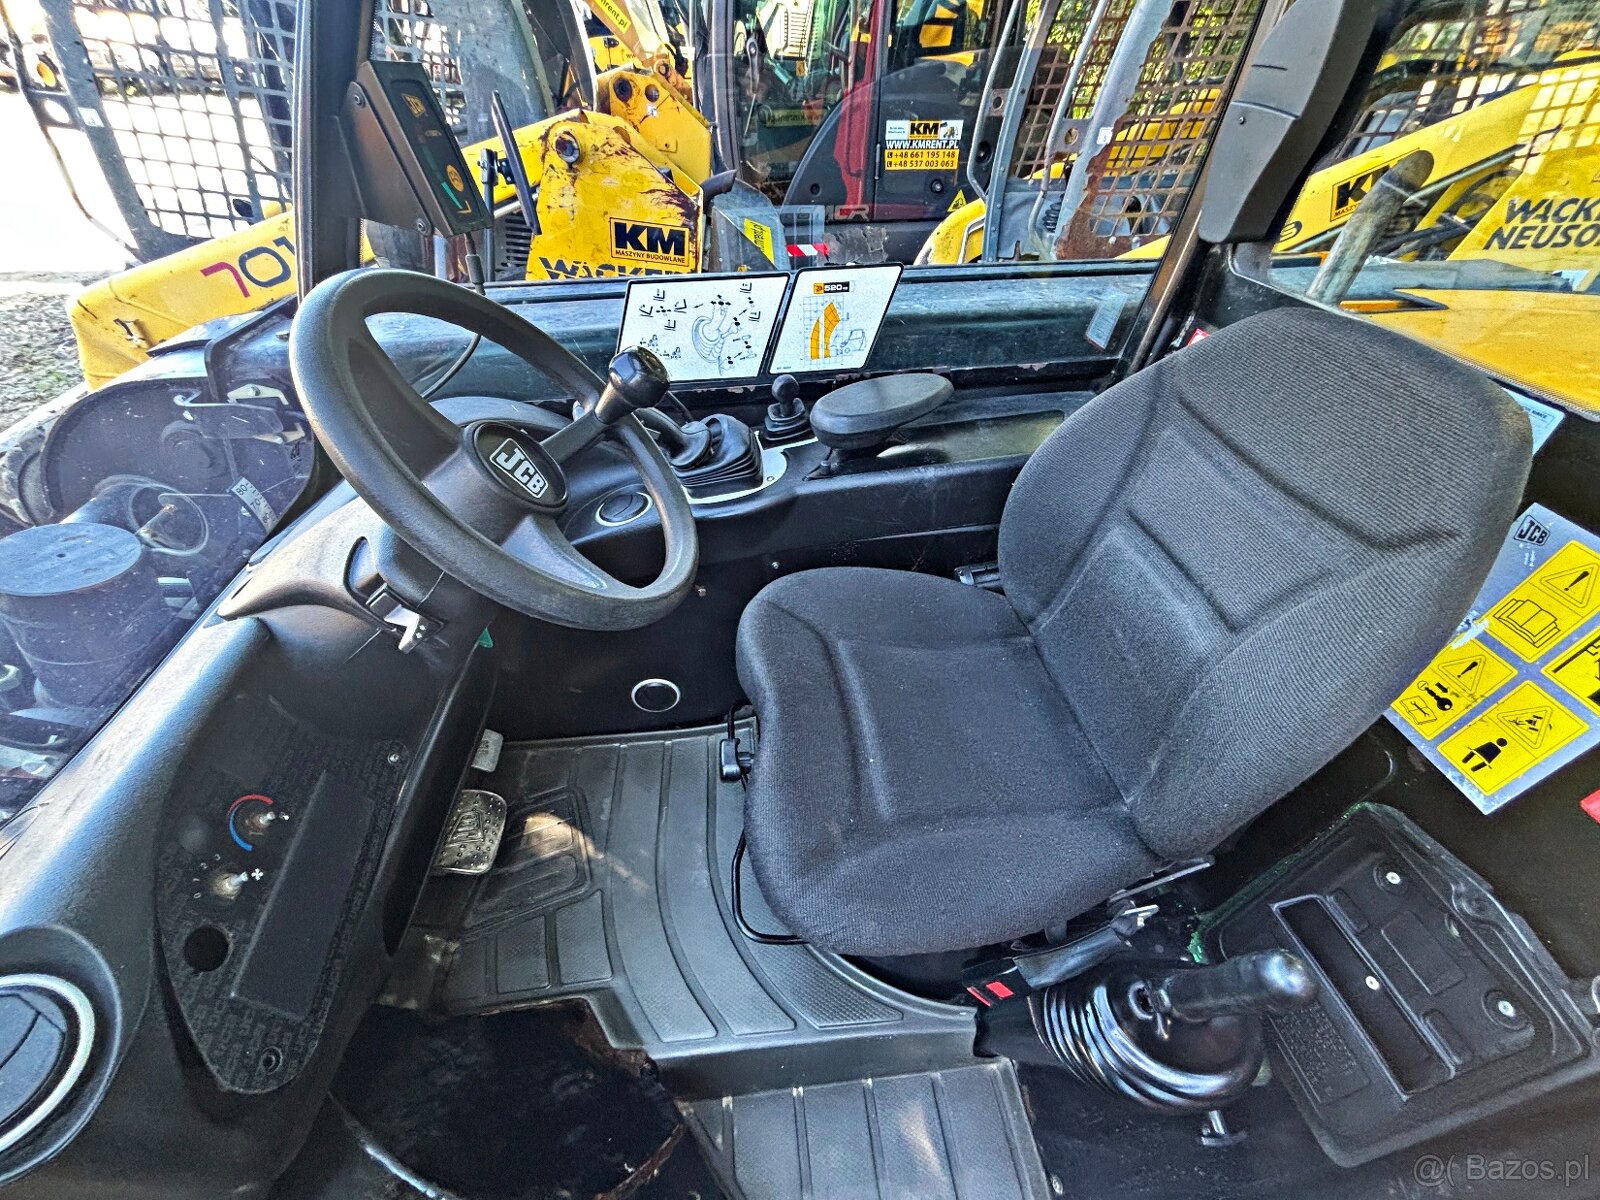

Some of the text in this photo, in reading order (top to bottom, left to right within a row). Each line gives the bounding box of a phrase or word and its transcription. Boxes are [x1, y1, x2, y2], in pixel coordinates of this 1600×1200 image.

[910, 122, 940, 135] KM
[885, 140, 959, 149] WWW.KMRENT.PL
[894, 151, 956, 159] +48 661 195 148
[893, 160, 954, 168] +48 537 003 063
[614, 221, 686, 257] KM
[615, 249, 686, 264] MASZYNY BUDOWLANE
[495, 447, 545, 494] JCB
[235, 484, 248, 496] 80
[1517, 519, 1548, 544] JCB
